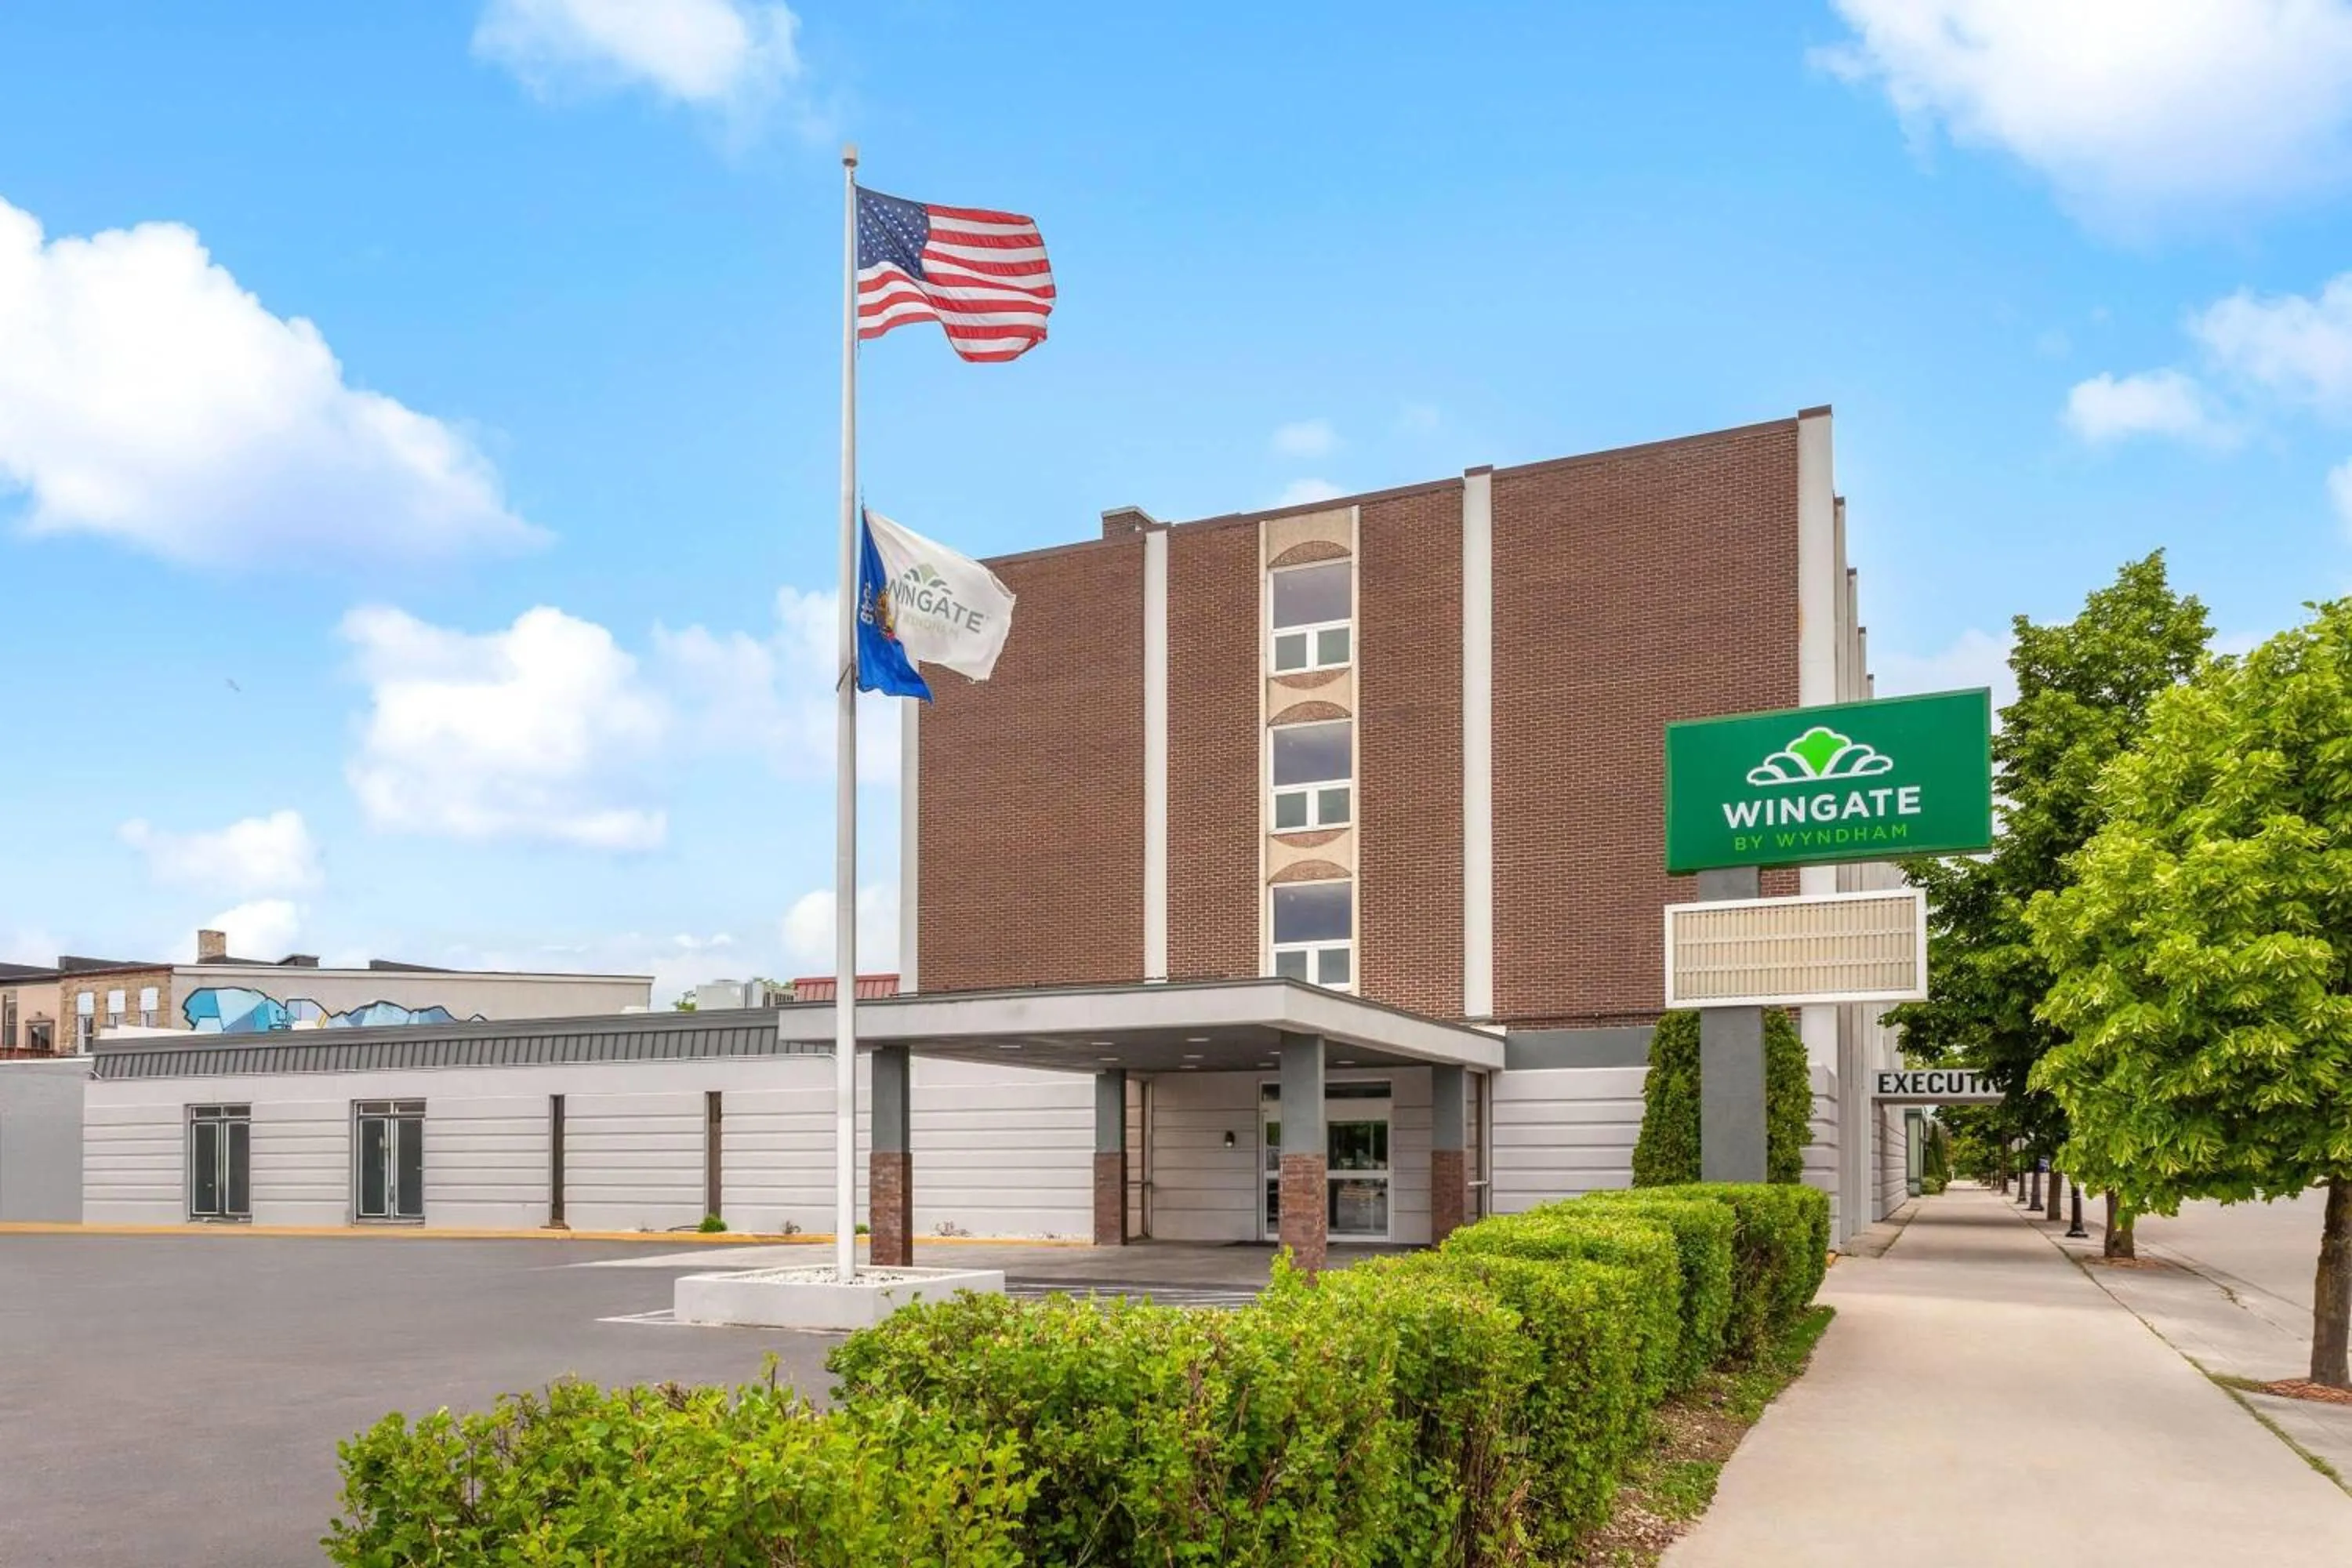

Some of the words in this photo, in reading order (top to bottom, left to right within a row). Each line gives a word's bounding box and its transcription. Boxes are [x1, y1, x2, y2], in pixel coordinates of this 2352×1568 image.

[1722, 786, 1921, 829] WINGATE
[1734, 835, 1762, 851] BY
[1777, 824, 1907, 848] WYNDHAM
